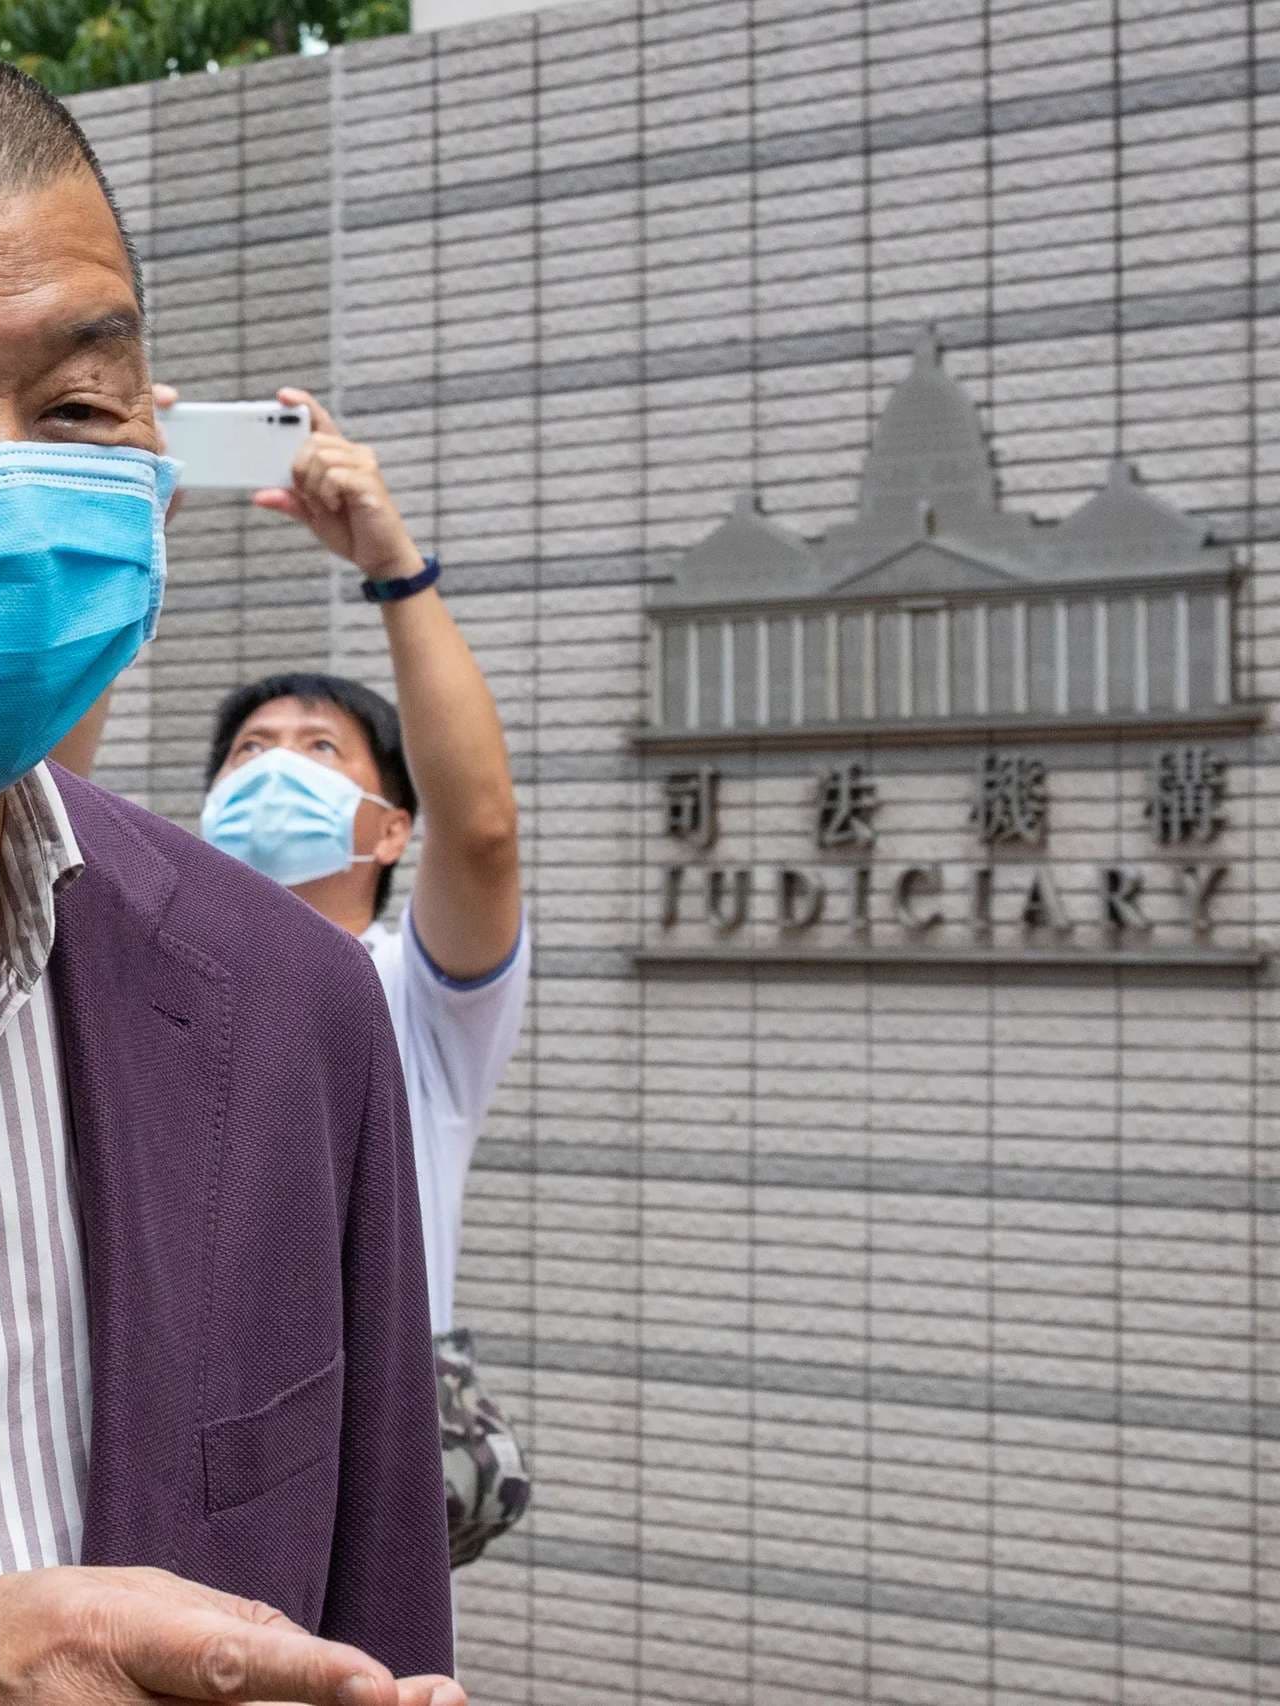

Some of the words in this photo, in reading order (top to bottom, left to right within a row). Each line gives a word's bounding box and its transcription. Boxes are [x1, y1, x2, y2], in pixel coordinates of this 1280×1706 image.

[663, 744, 1232, 848] 司法機構
[658, 862, 1232, 936] JUDICIARY
